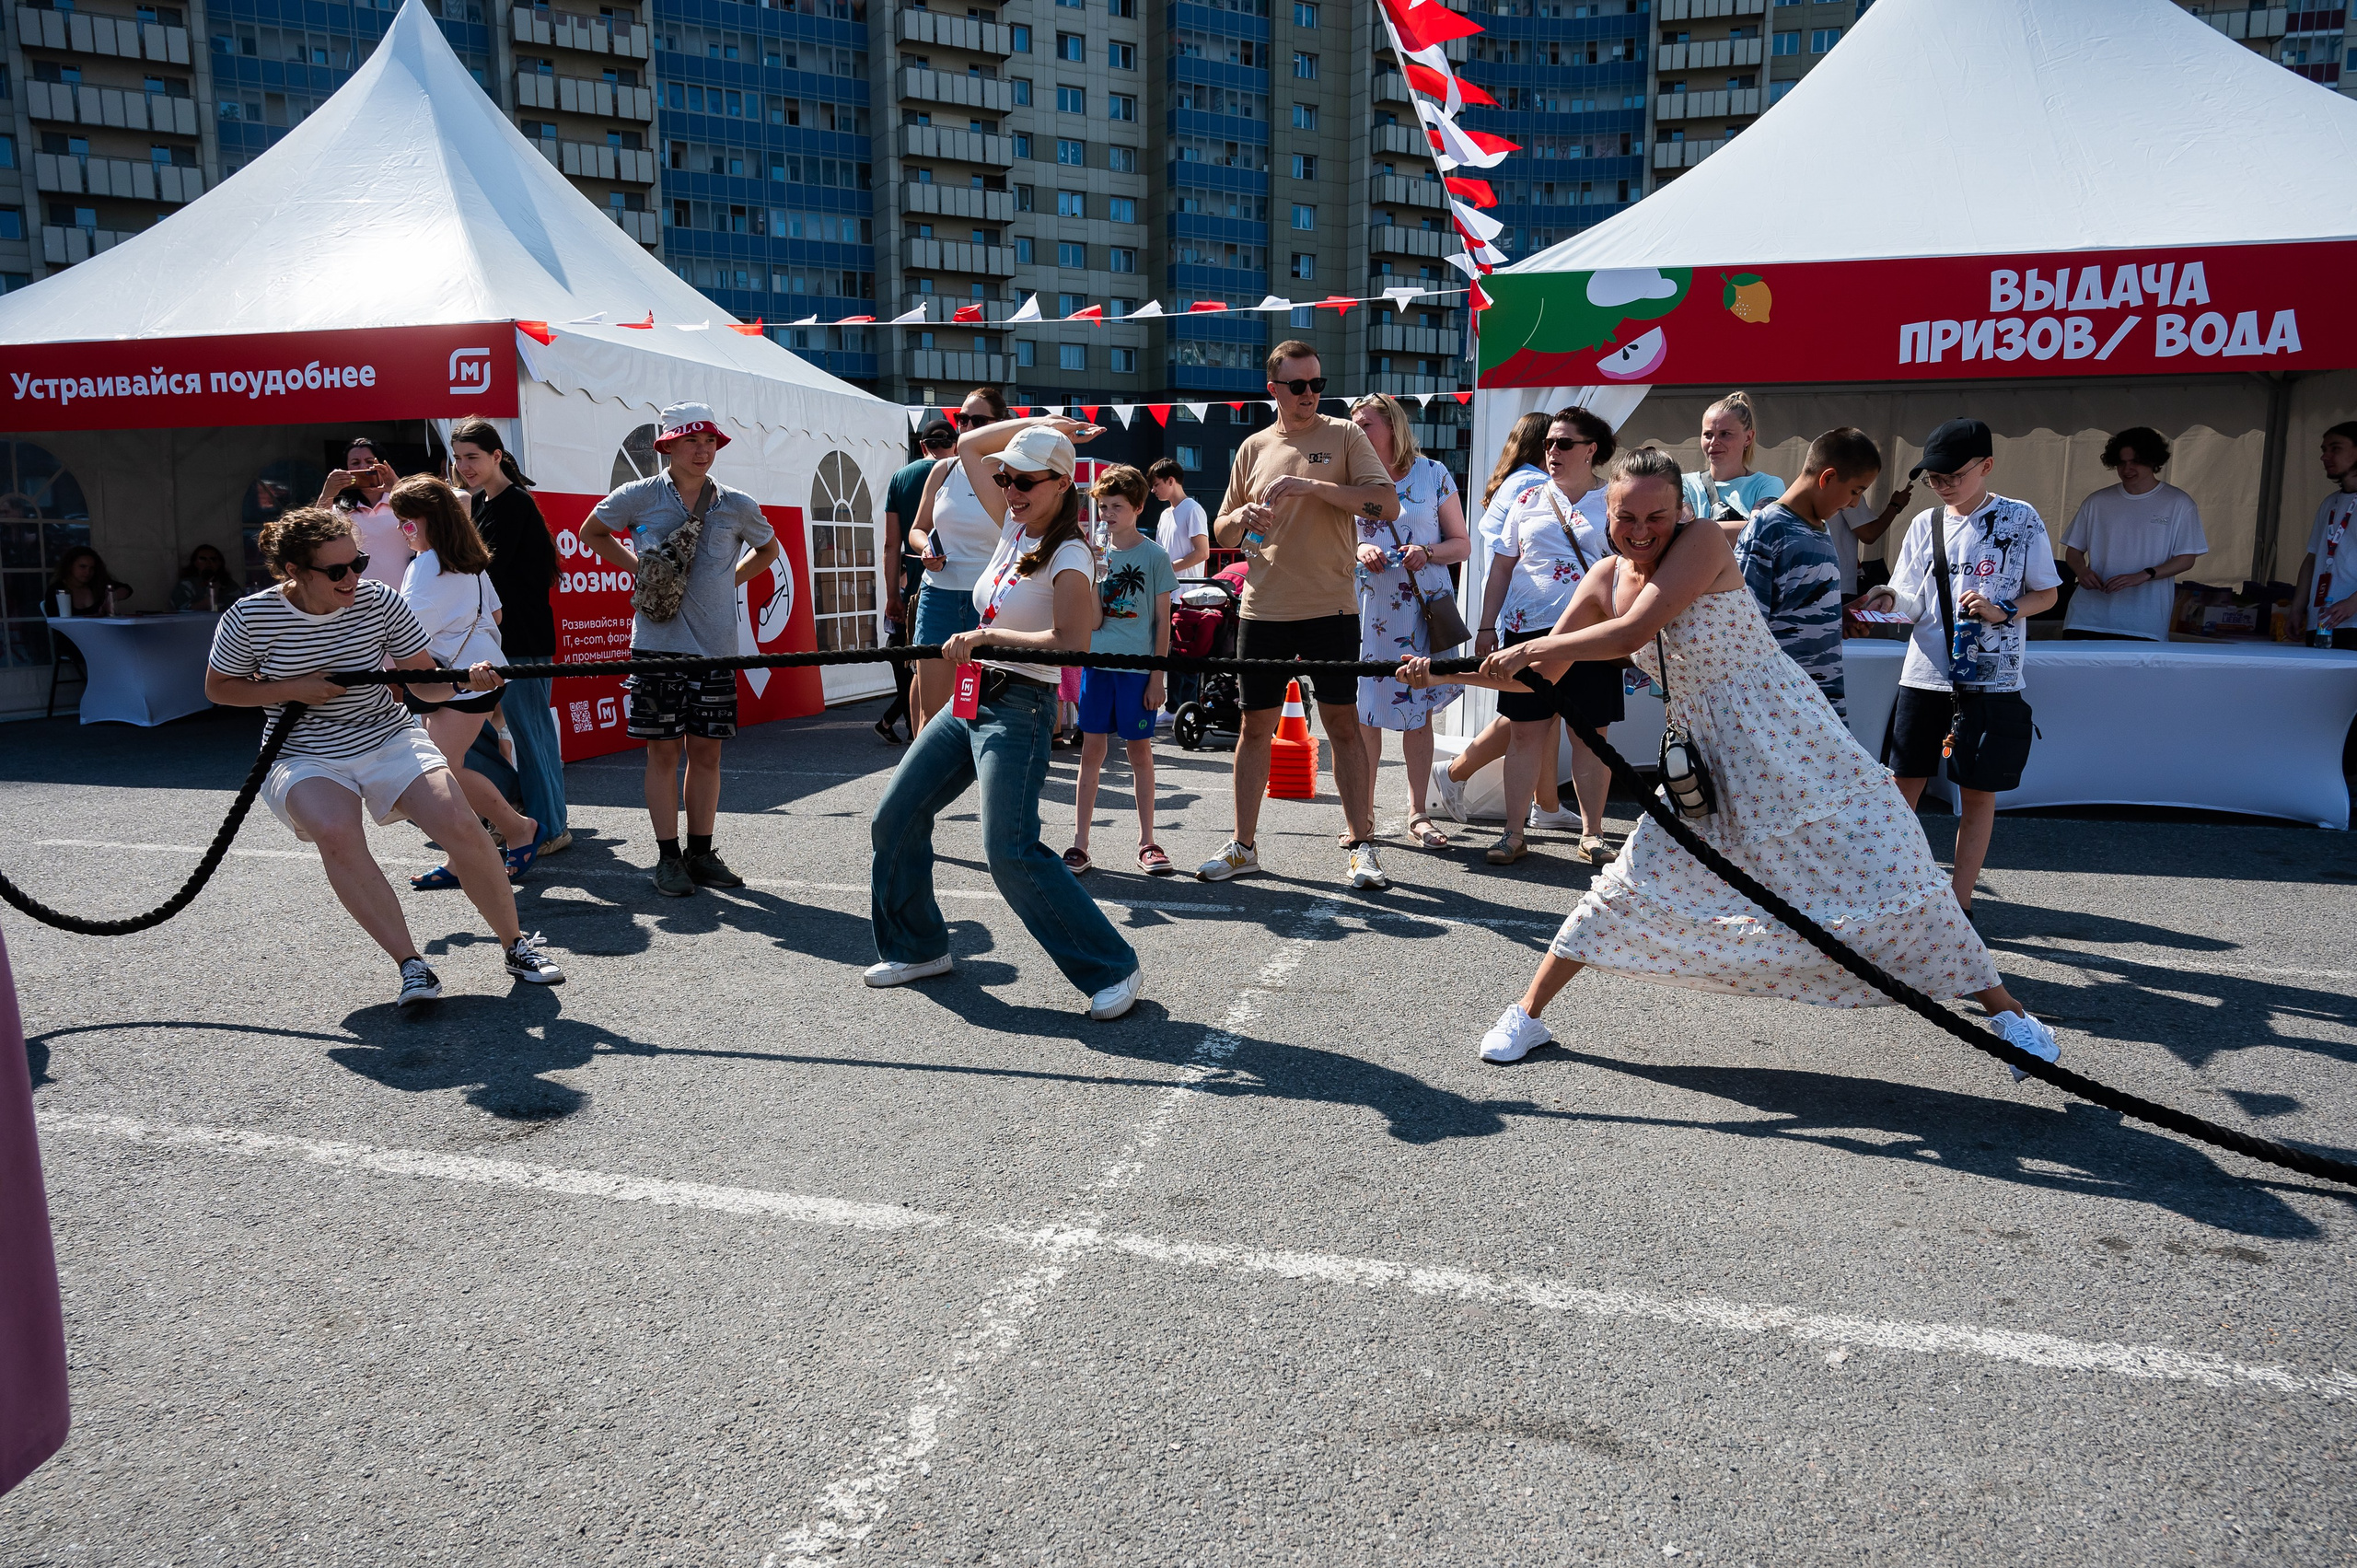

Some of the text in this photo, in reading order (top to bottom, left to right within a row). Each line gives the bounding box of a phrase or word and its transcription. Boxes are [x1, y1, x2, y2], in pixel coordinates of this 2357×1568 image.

[1990, 261, 2211, 312] ВЫДАЧА
[2155, 308, 2302, 357] ВОДА
[10, 360, 376, 405] Устраивайся поудобнее
[560, 572, 638, 593] возмо
[562, 616, 618, 630] Развивайся
[574, 635, 606, 645] e-com,
